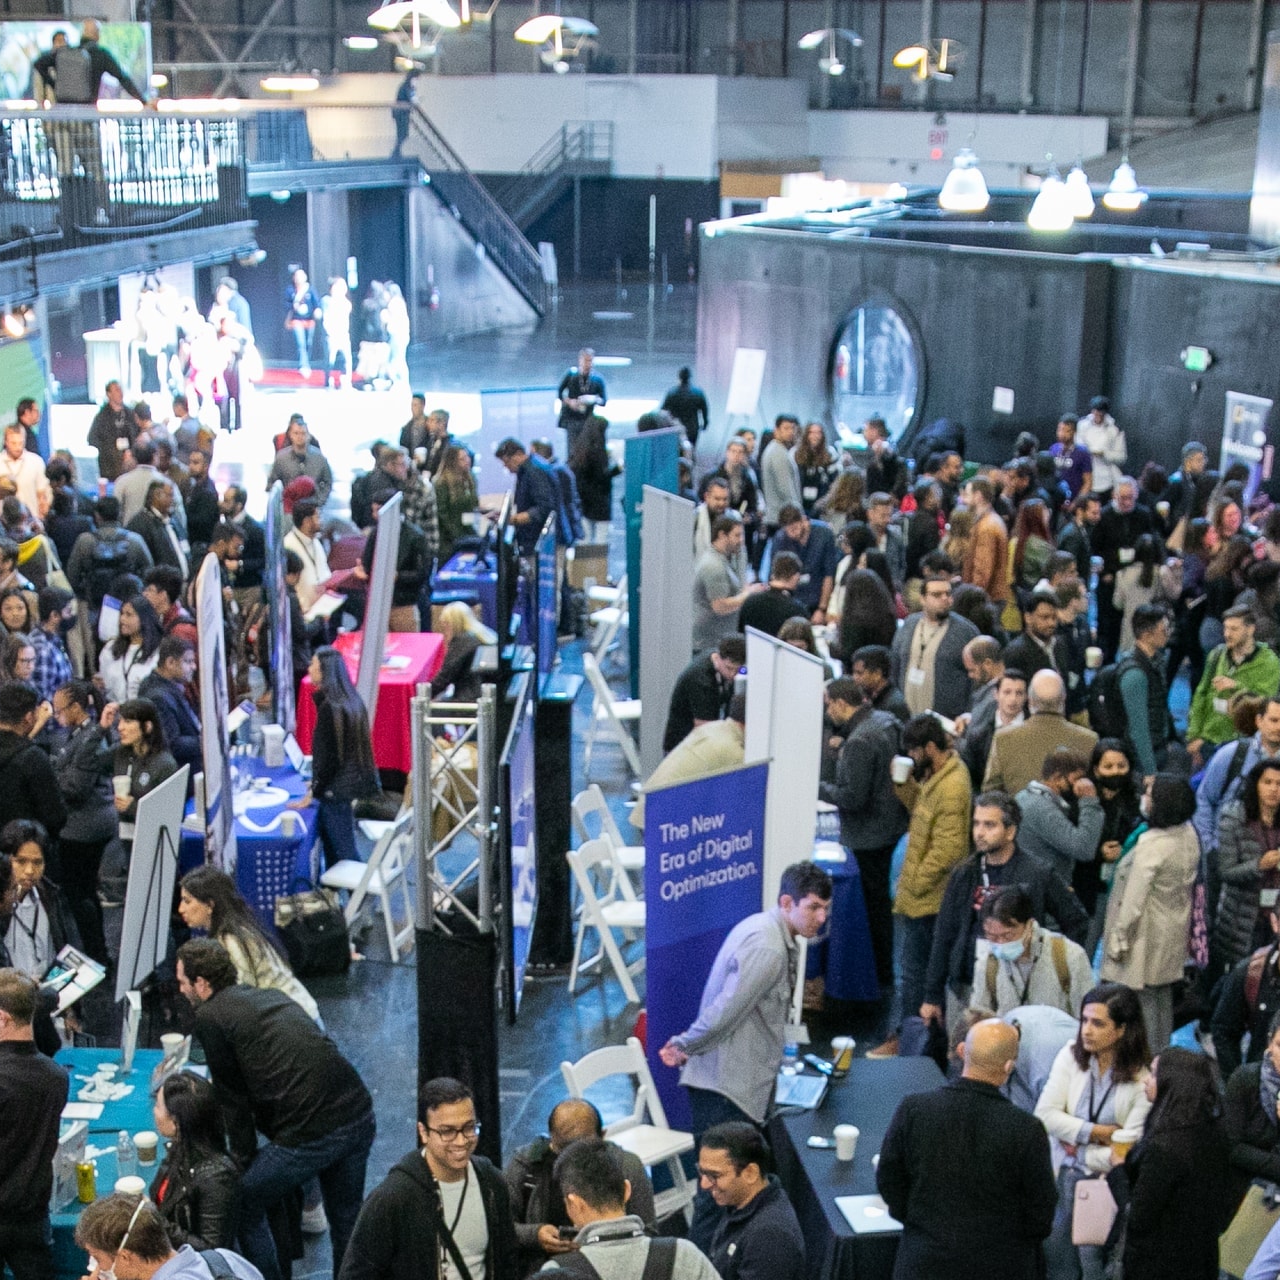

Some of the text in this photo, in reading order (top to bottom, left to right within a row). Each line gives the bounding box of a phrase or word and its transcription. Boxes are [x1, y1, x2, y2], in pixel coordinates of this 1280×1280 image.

[659, 813, 725, 843] The New
[661, 829, 753, 873] Era of Digital
[661, 861, 758, 902] Optimization.
